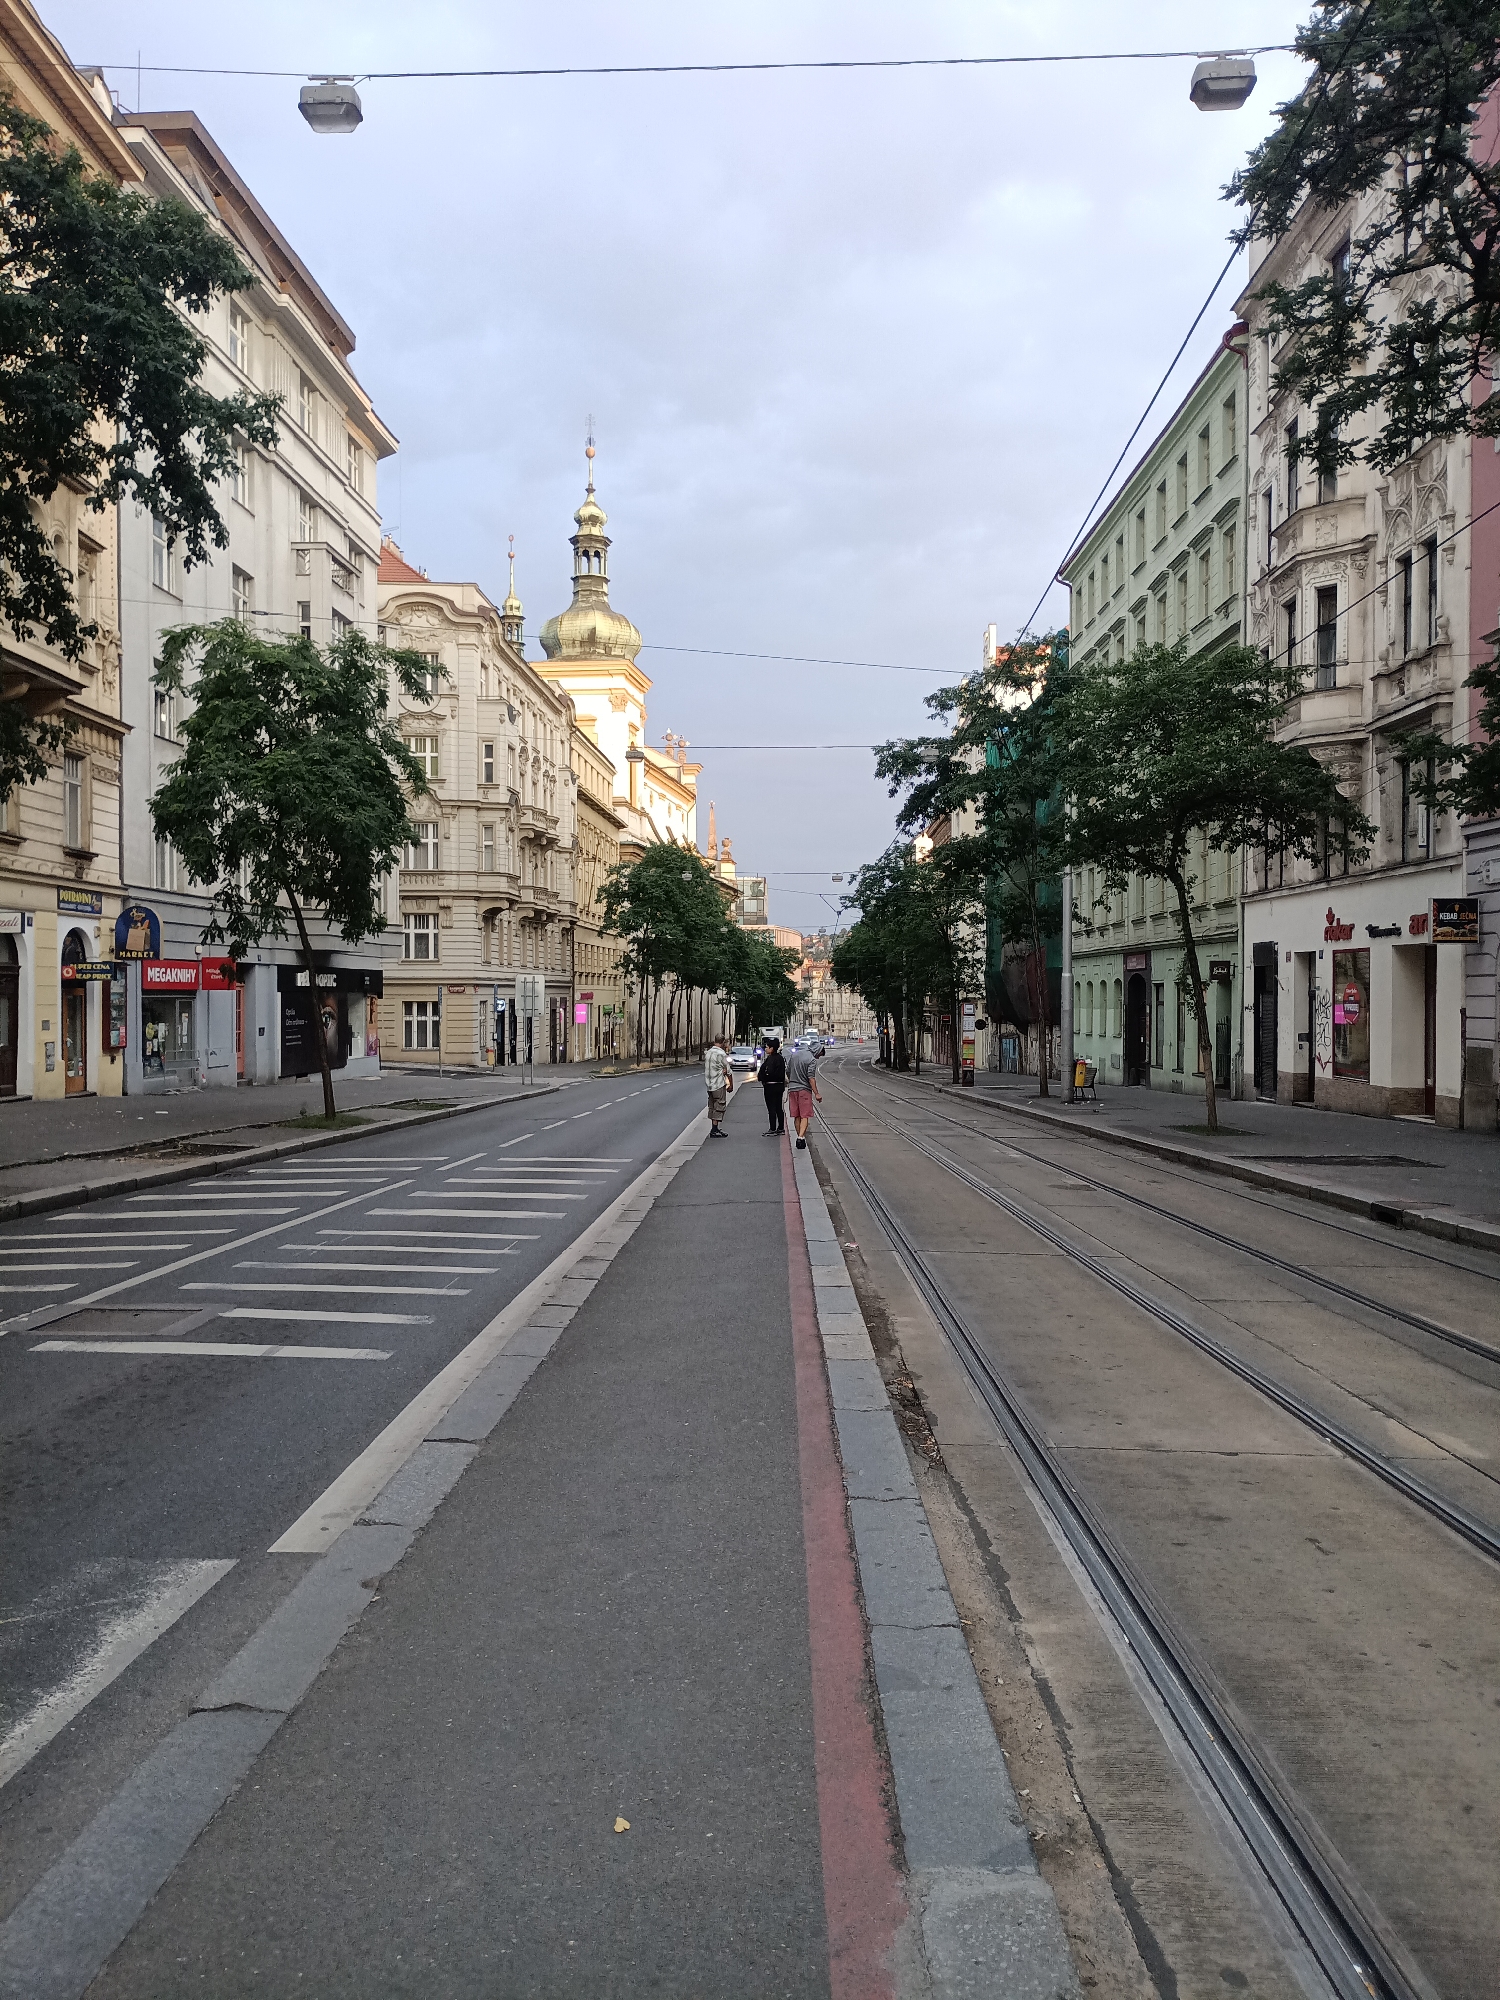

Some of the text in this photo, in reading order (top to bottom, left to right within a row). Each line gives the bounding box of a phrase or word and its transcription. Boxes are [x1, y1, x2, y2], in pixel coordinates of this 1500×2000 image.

[1439, 912, 1458, 920] KEBAB
[119, 951, 154, 959] MARKET
[147, 967, 197, 983] MEGAKNIHY
